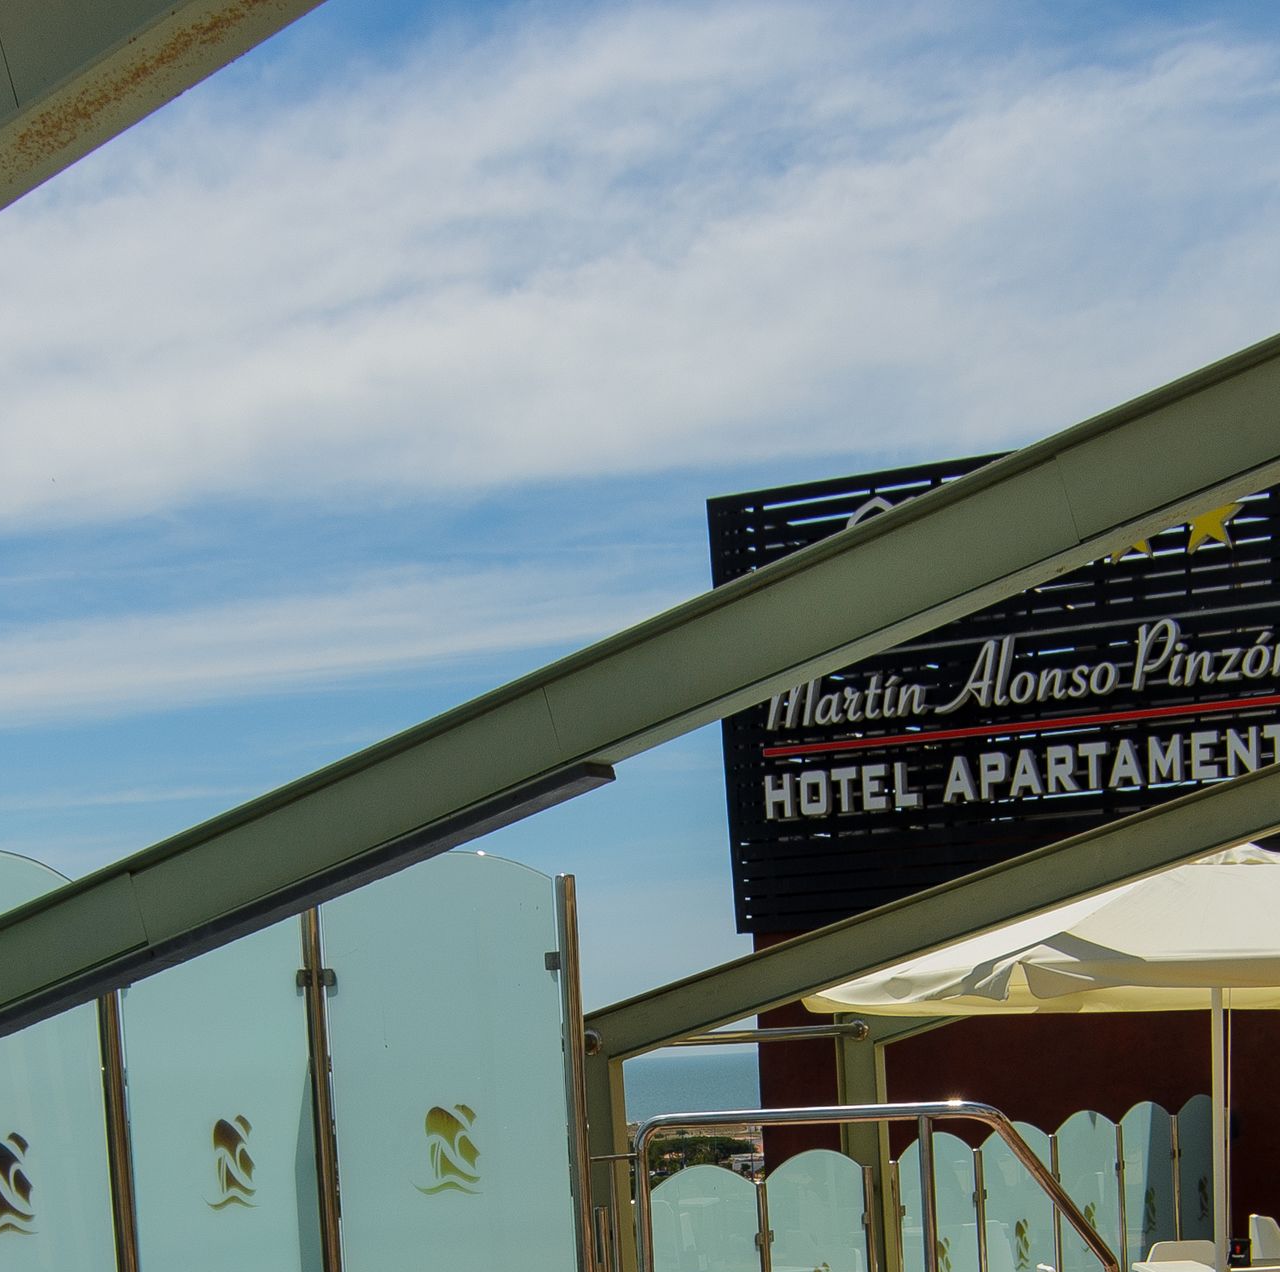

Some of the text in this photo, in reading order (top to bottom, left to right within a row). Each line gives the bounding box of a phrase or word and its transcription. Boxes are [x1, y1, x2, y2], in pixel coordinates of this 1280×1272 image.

[766, 674, 927, 730] Martín
[934, 635, 1119, 714] Alonso
[764, 761, 923, 821] HOTEL
